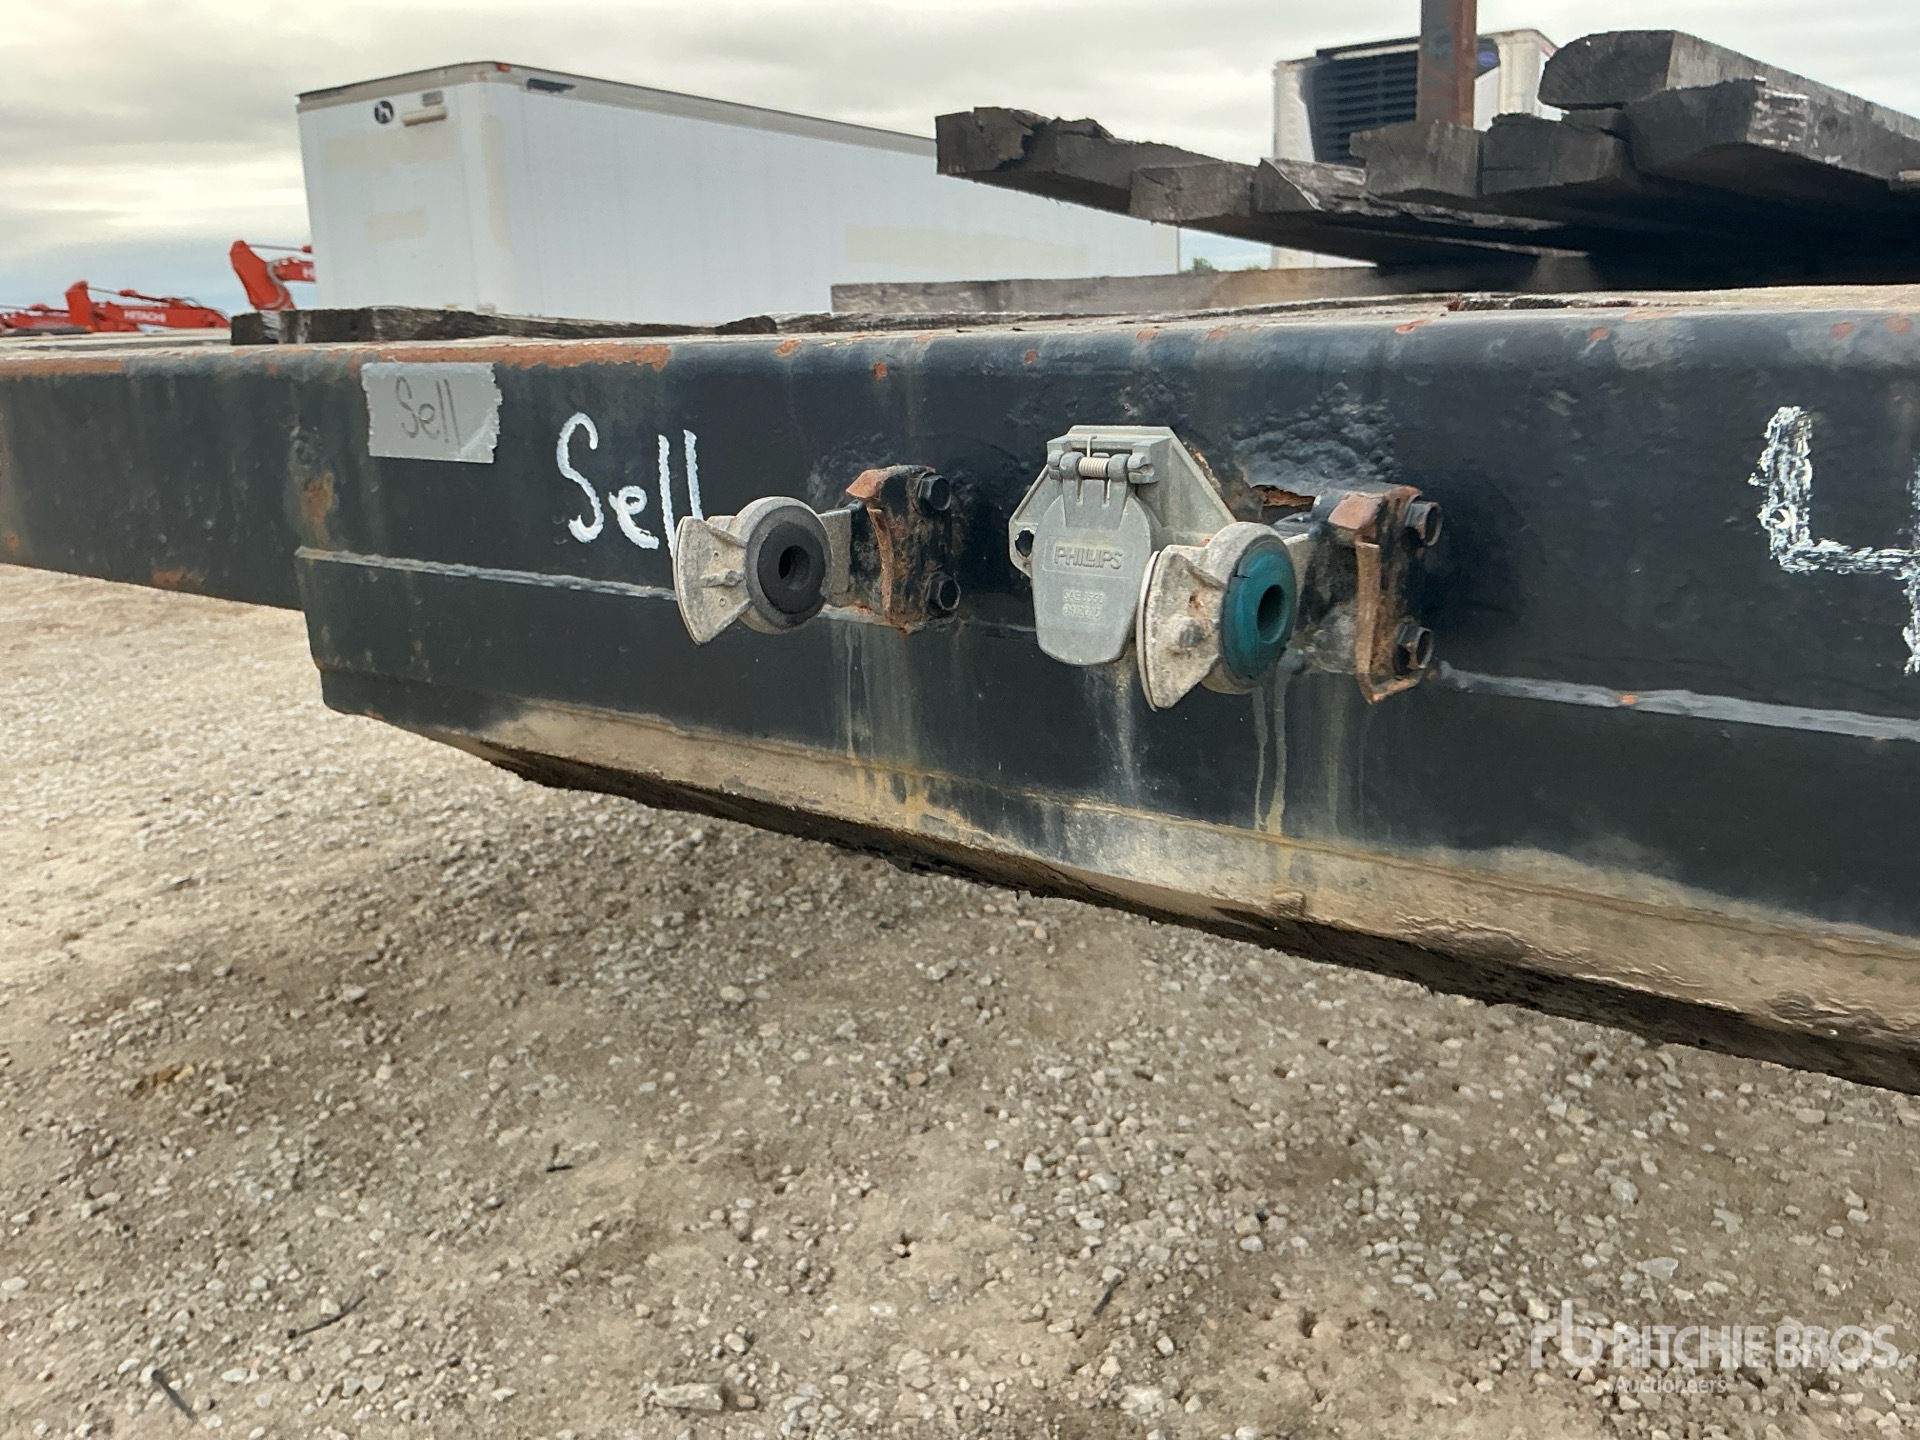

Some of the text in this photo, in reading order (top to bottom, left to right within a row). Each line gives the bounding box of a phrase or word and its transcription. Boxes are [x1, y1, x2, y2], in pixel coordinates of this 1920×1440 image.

[124, 309, 167, 323] HITACHI
[395, 376, 461, 452] Sell
[556, 411, 703, 557] Sell
[1053, 545, 1123, 570] PHILLIPS
[1063, 589, 1081, 602] SAE
